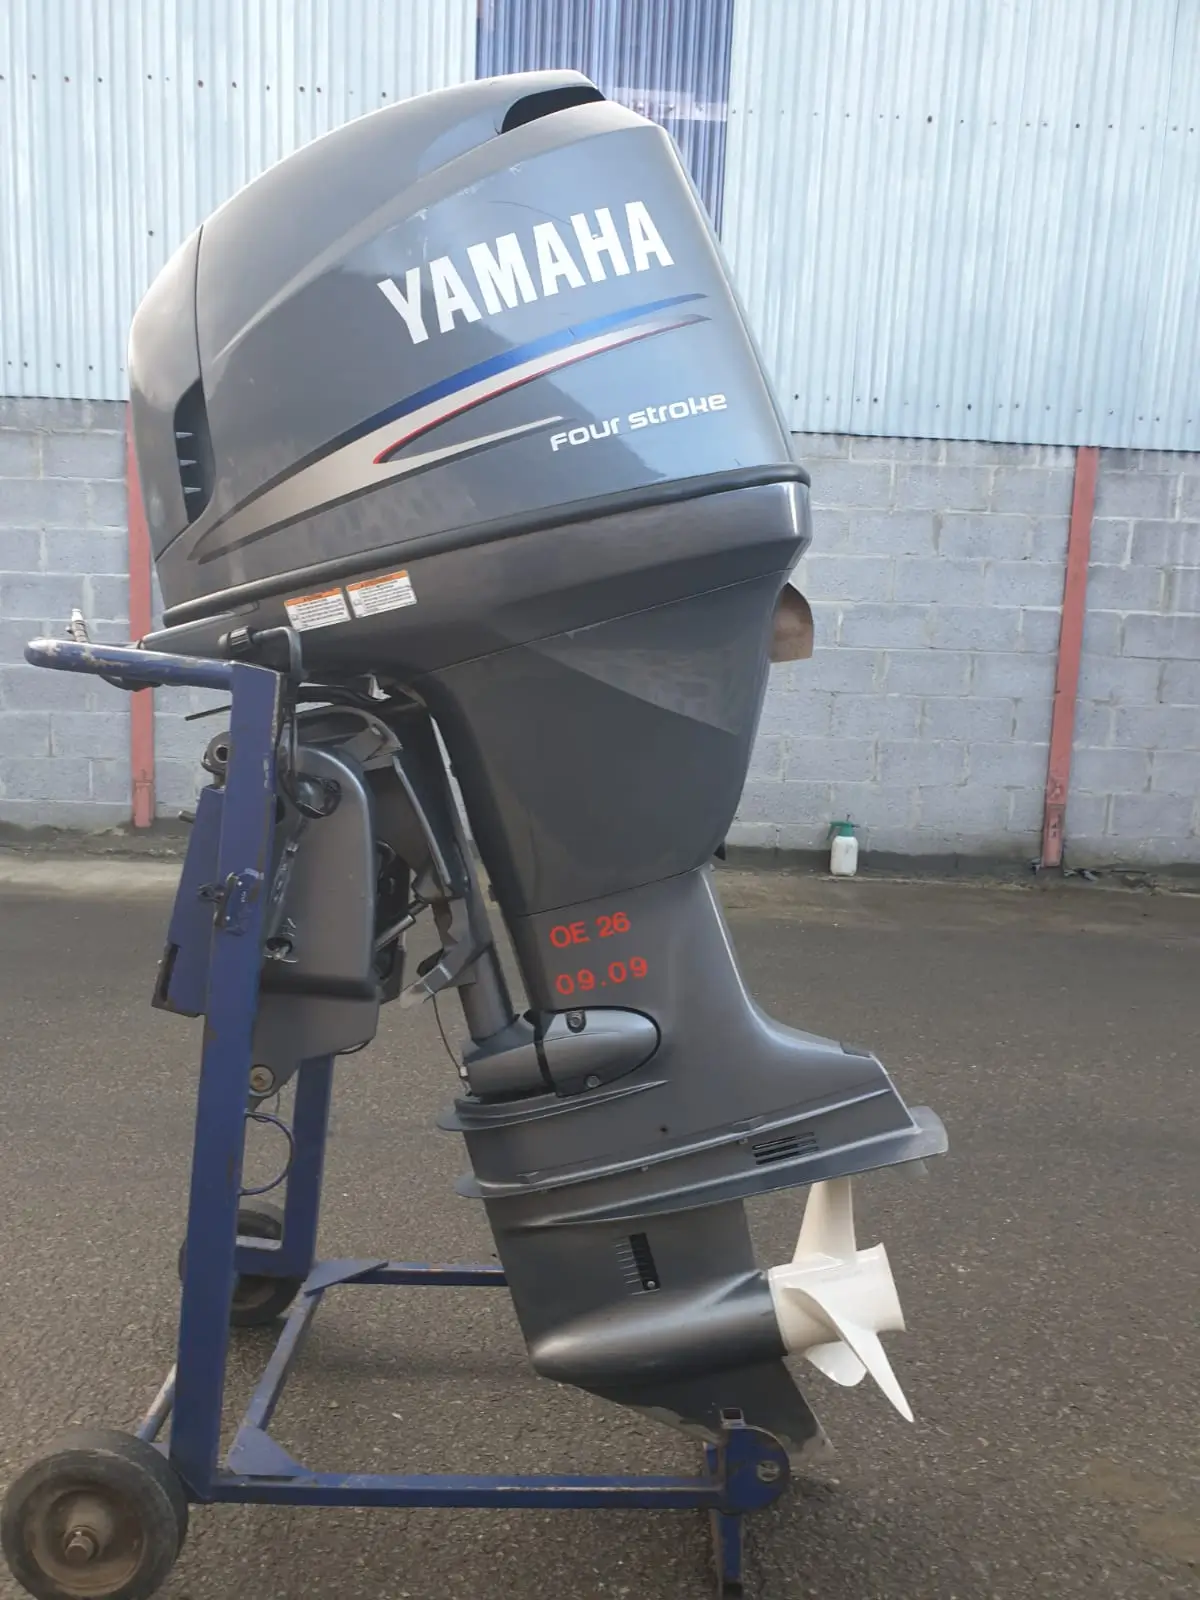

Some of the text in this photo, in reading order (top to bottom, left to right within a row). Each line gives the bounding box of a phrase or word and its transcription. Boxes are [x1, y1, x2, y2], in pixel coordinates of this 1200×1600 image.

[377, 200, 675, 345] YAMAHA
[628, 393, 728, 430] stroke
[549, 911, 631, 948] OE 26
